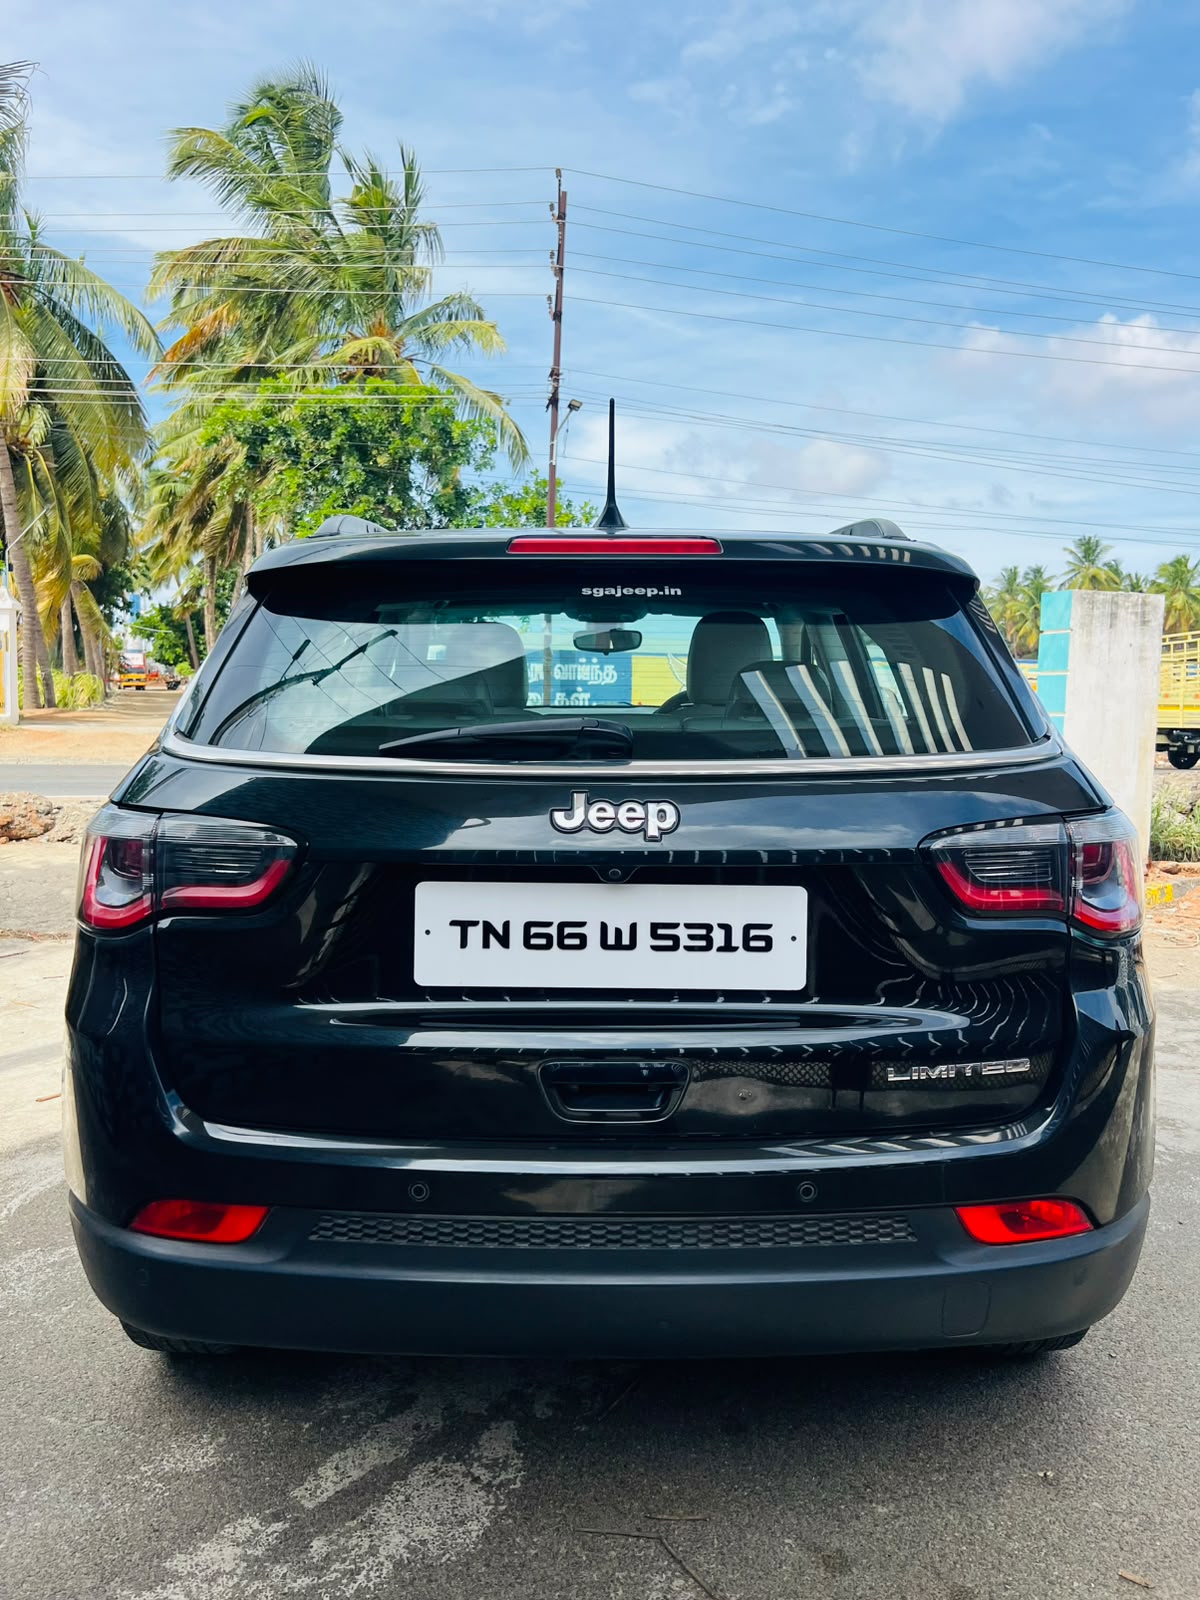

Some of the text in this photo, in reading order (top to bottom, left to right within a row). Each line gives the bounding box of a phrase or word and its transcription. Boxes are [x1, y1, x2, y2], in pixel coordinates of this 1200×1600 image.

[581, 586, 682, 597] sgajeep.in
[551, 790, 680, 841] Jeep
[449, 920, 773, 952] TN 66 W 5316
[886, 1058, 1031, 1082] LIMITED
